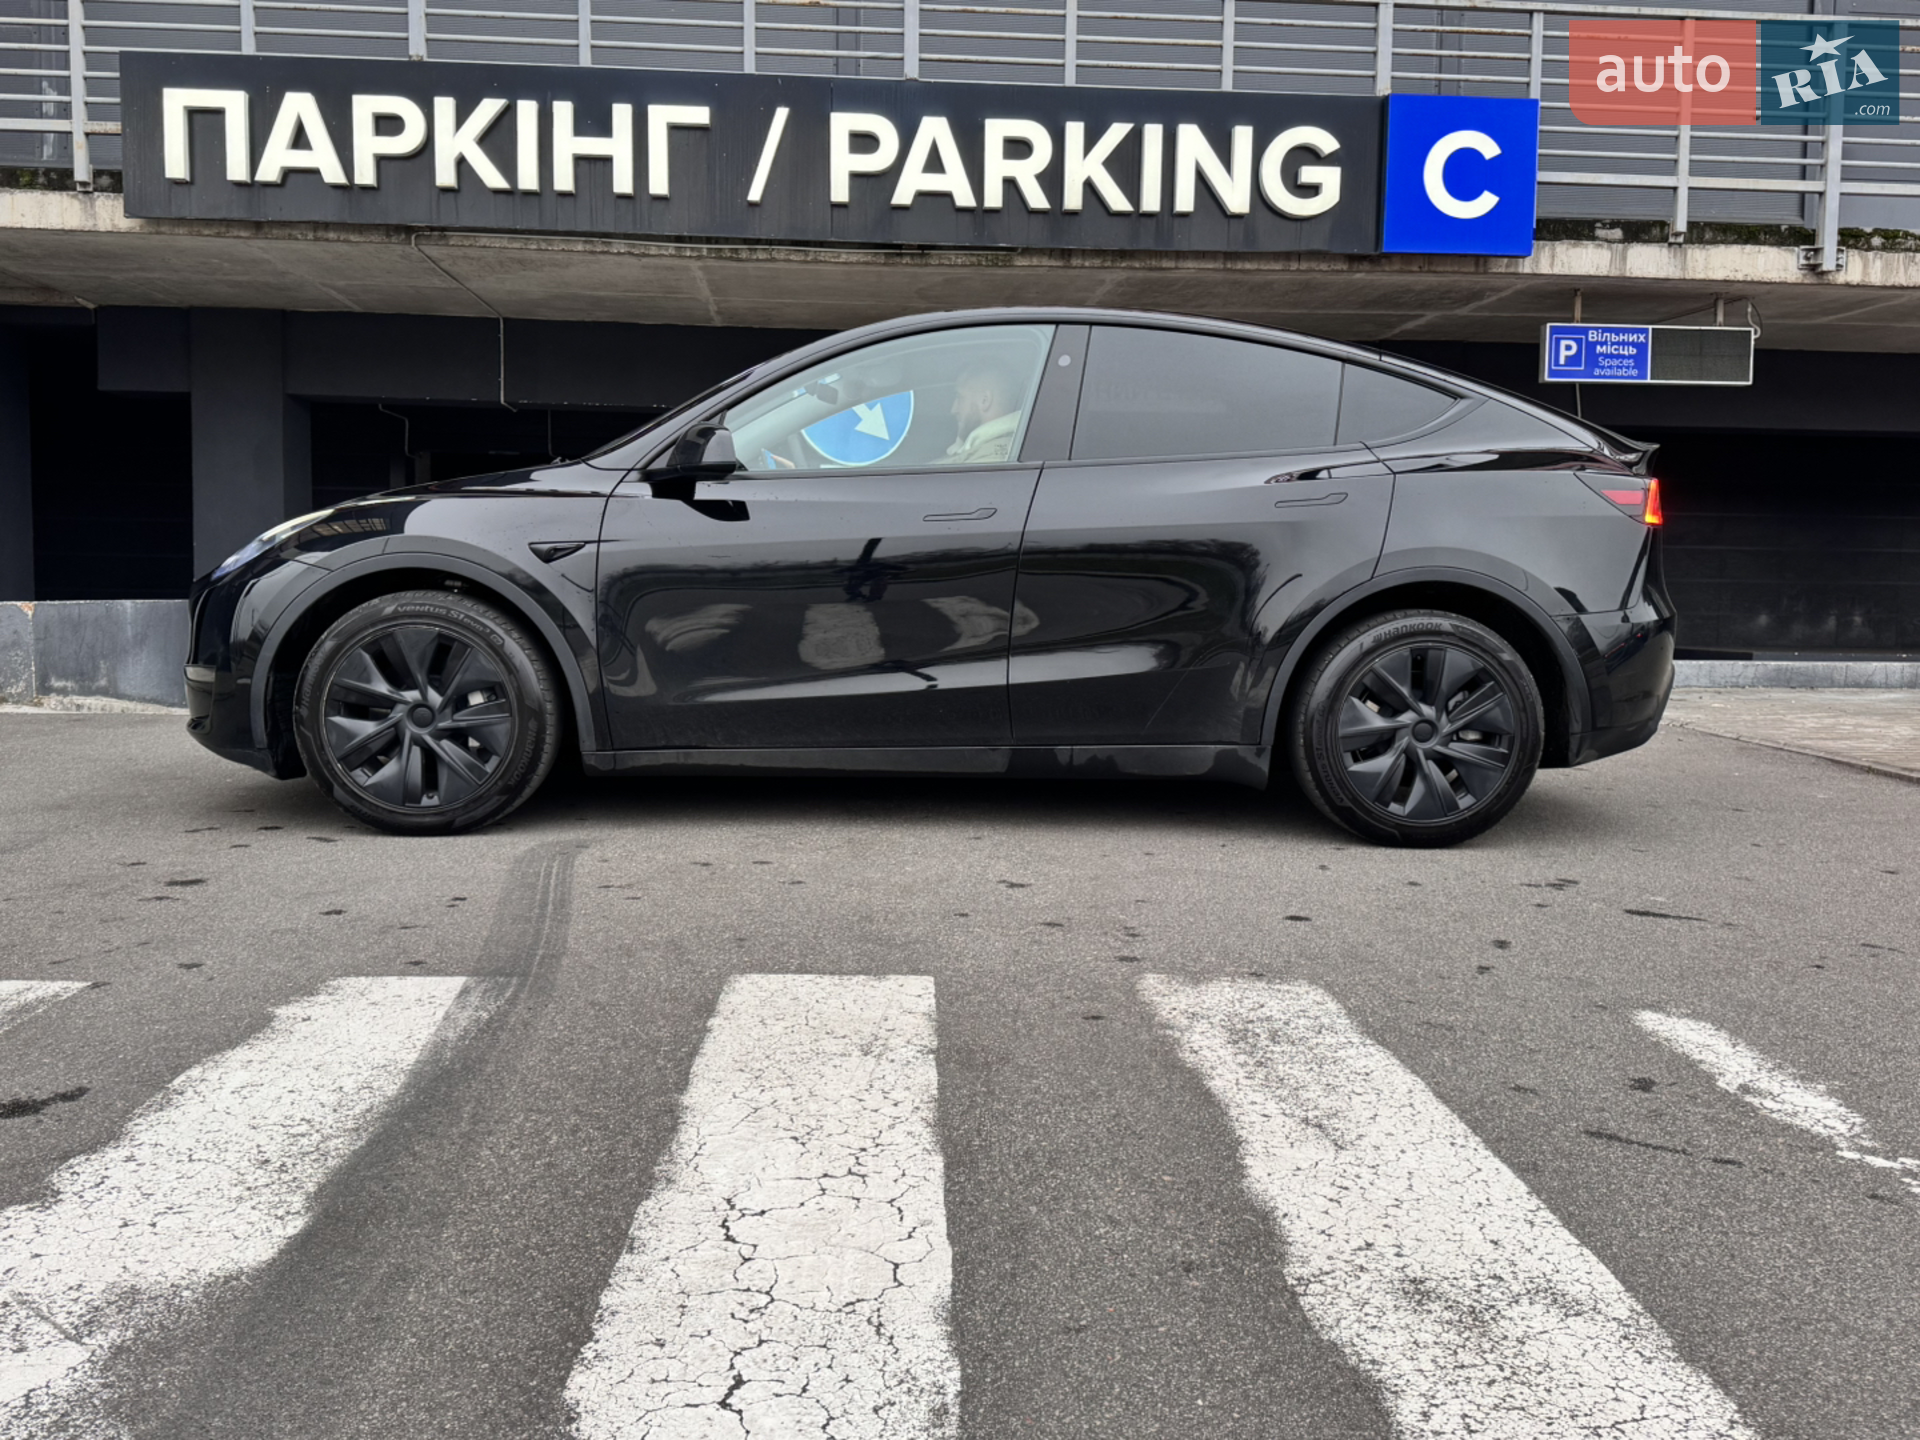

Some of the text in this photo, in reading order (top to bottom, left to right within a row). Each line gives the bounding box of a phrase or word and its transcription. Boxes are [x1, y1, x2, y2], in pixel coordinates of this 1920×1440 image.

[162, 87, 711, 197] ПАРКІНГ
[829, 111, 1342, 218] PARKING
[1423, 129, 1502, 219] C
[1588, 329, 1646, 343] Вільних
[1559, 339, 1578, 365] P
[1596, 342, 1637, 356] місць
[1598, 356, 1635, 367] Spaces
[1593, 367, 1639, 377] available
